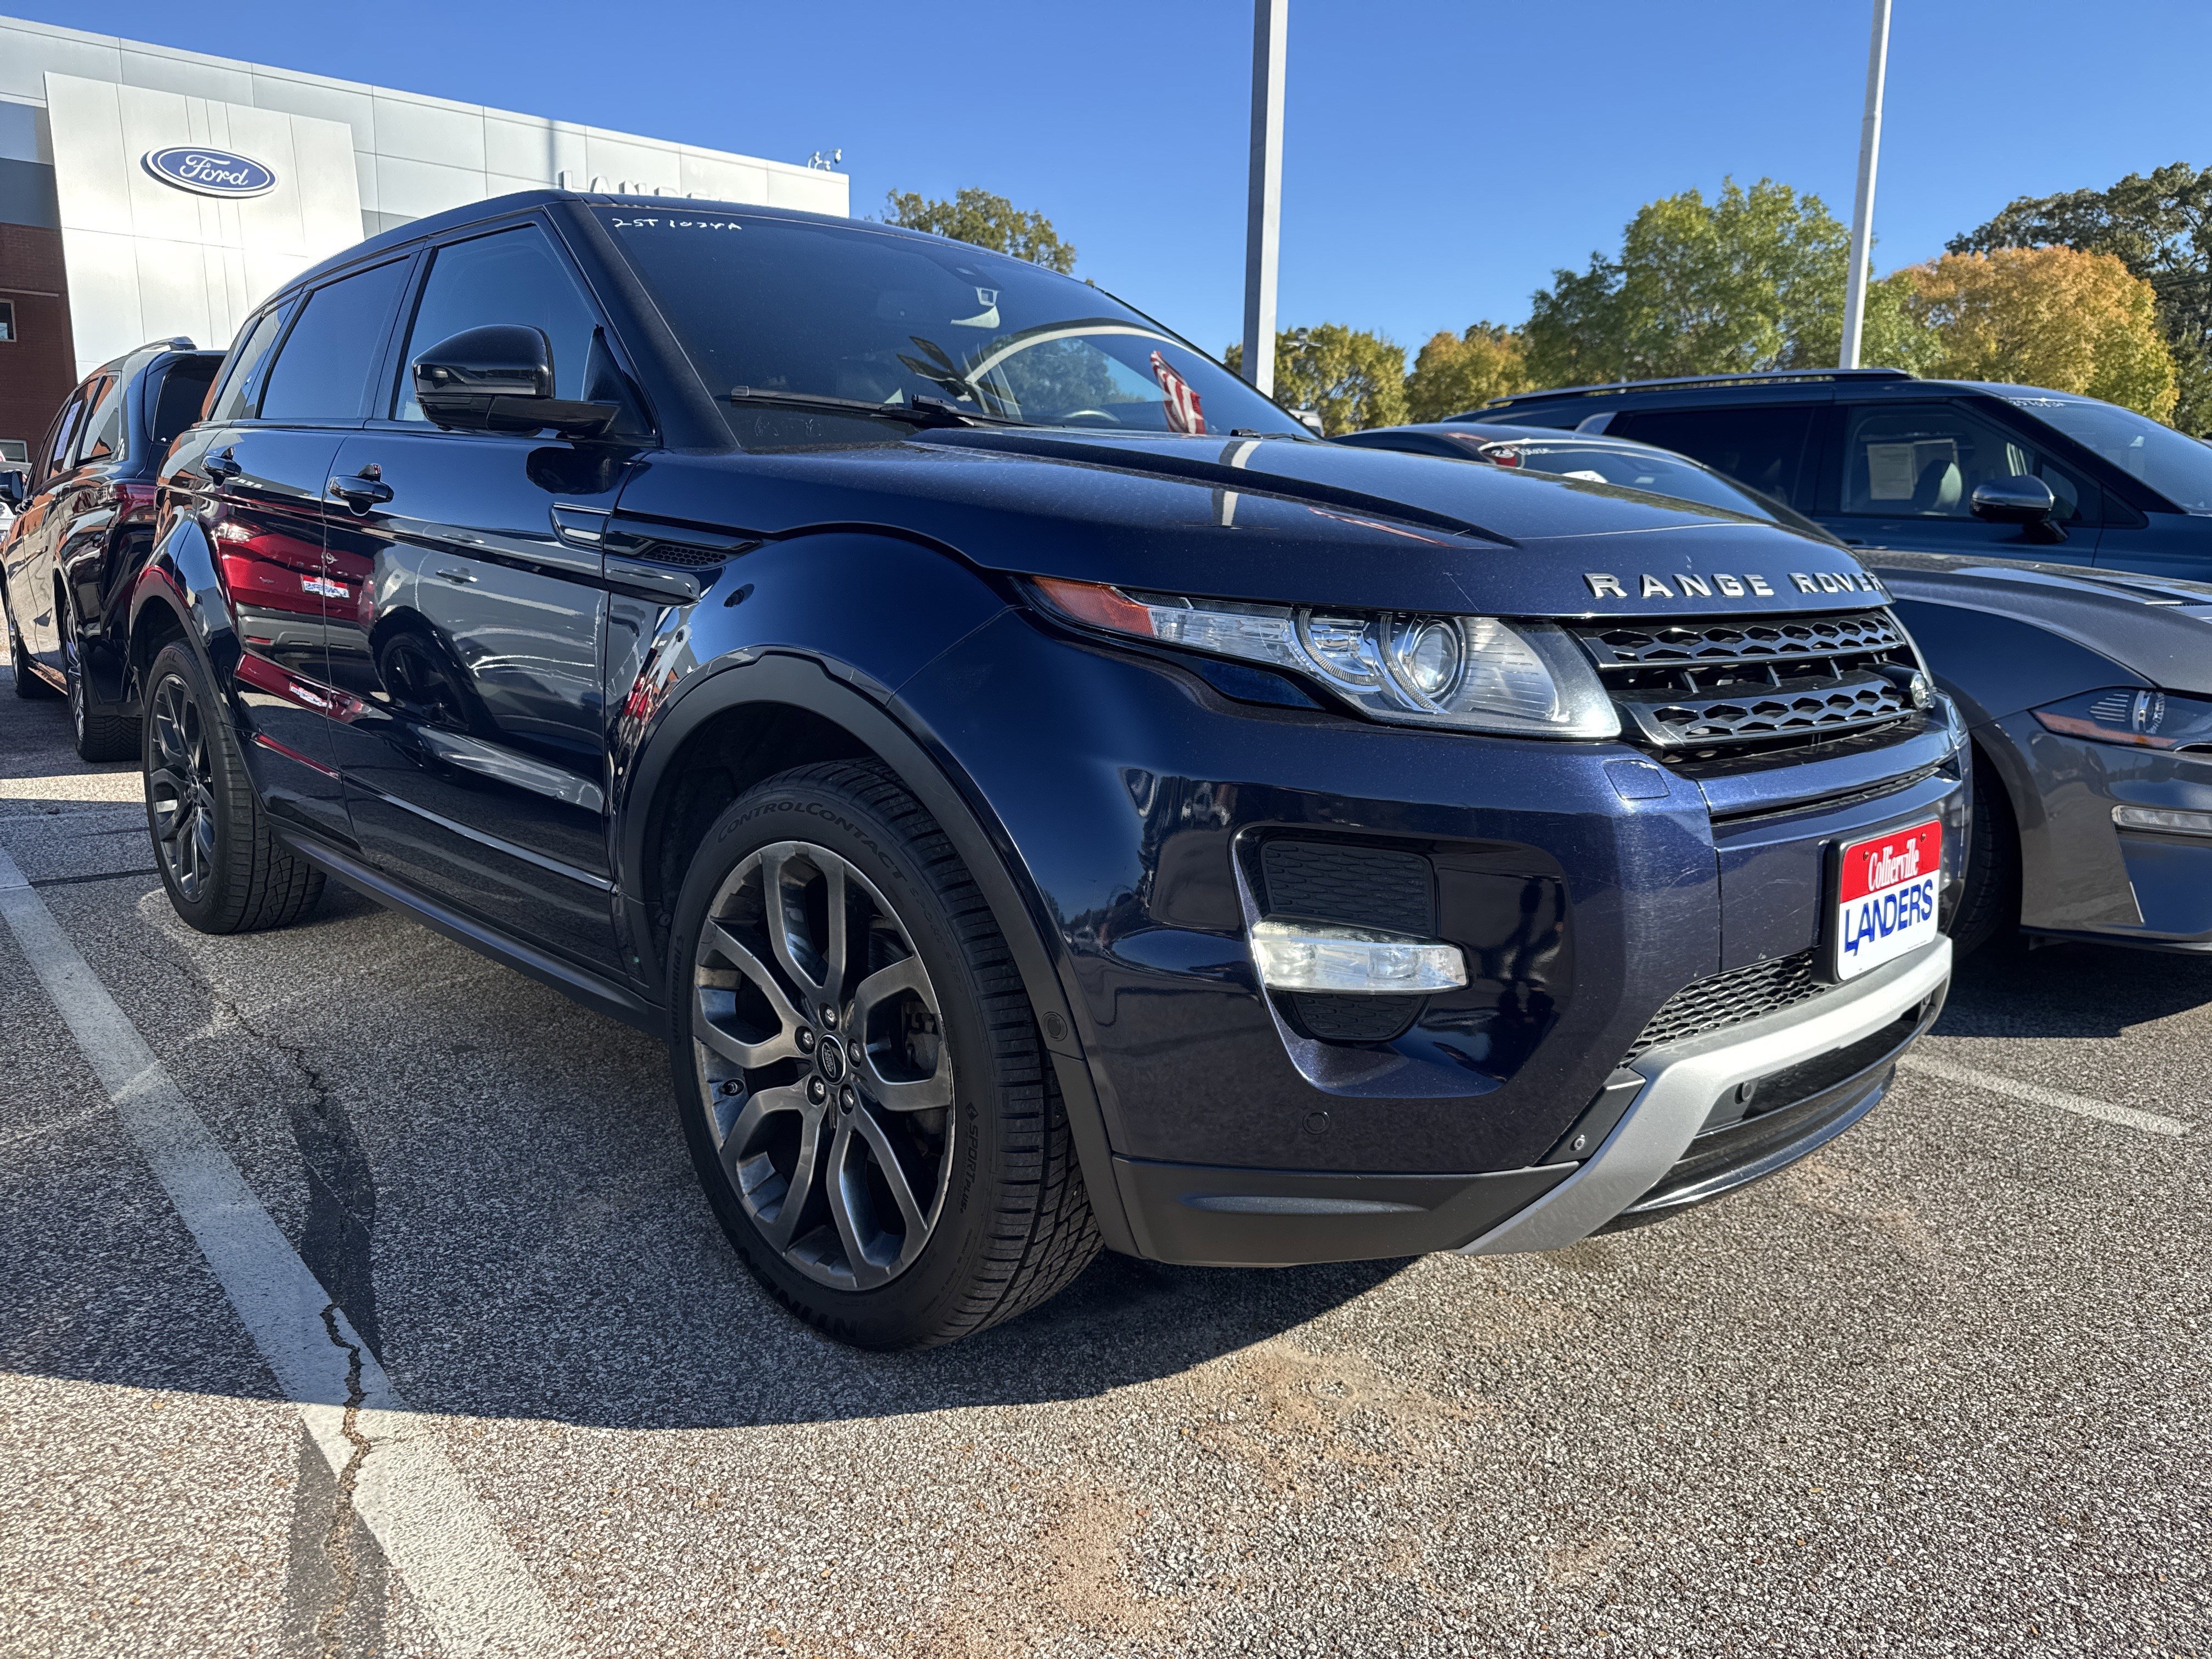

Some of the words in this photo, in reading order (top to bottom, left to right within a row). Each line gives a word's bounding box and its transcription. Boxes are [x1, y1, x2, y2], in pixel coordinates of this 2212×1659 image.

[179, 154, 249, 185] Ford
[1582, 572, 1775, 599] RANGE
[1788, 571, 1884, 594] ROVER
[1868, 837, 1920, 891] Collierville
[1844, 878, 1933, 957] LANDERS
